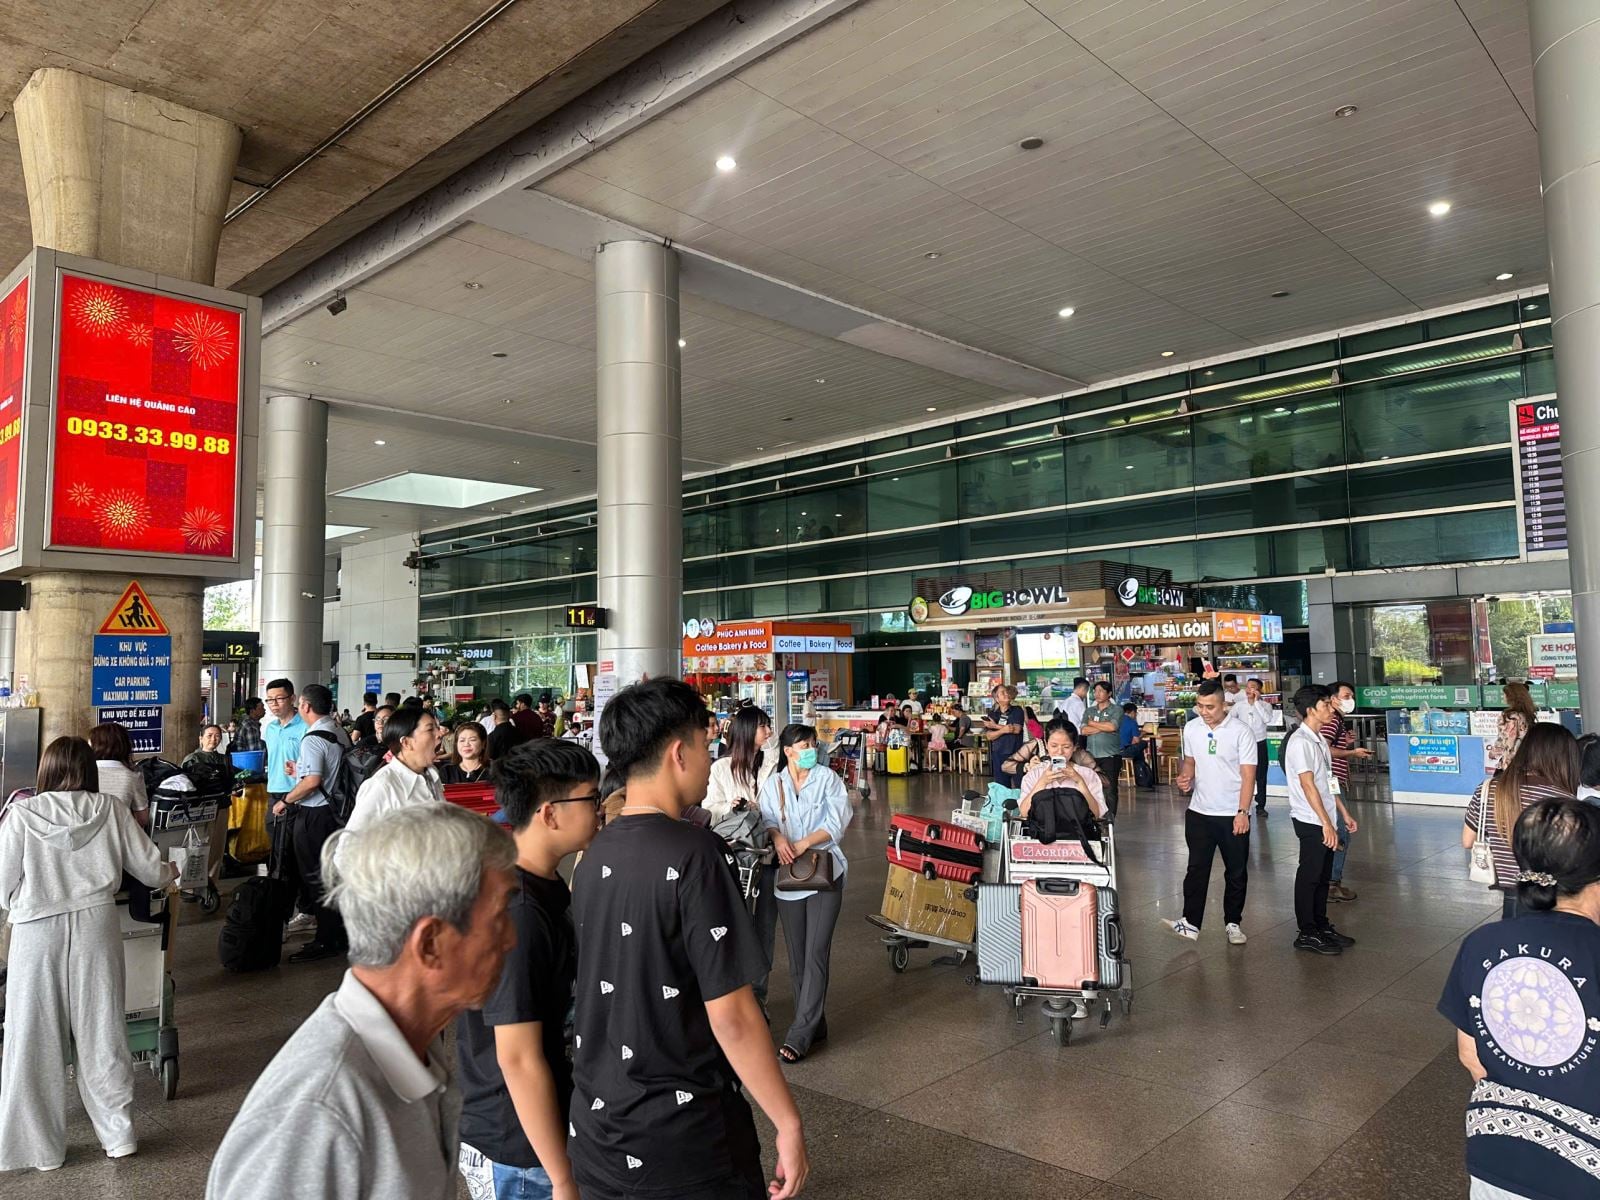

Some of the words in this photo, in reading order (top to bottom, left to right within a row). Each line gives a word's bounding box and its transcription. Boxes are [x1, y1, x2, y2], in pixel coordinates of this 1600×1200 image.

[106, 394, 127, 404] LIÊN
[130, 398, 142, 408] HỆ
[144, 400, 175, 412] QUẢNG
[178, 405, 196, 414] CÁO
[67, 417, 230, 454] 0933.33.99.88
[568, 609, 584, 624] 11
[717, 629, 733, 638] PHÚC
[1100, 623, 1124, 640] MÓN
[1126, 624, 1159, 639] NGON
[1162, 620, 1180, 638] SÀI
[1183, 619, 1210, 637] GÒN
[119, 642, 132, 651] KHU
[135, 640, 147, 654] VỰC
[228, 645, 243, 655] 12
[695, 643, 717, 652] Coffee
[719, 642, 741, 651] Bakery
[750, 640, 767, 648] Food
[810, 640, 831, 649] Bakery
[838, 640, 852, 648] Food
[1541, 644, 1553, 652] XE
[110, 656, 118, 666] XE
[119, 655, 138, 666] KHÔNG
[138, 654, 150, 666] QUÁ
[150, 657, 154, 666] 3
[155, 654, 169, 666] PHÚT
[114, 676, 126, 686] CAR
[127, 676, 150, 686] PARKING
[103, 691, 129, 701] MAXIMUM
[130, 691, 134, 700] 3
[135, 690, 158, 700] MINUTES
[1363, 688, 1387, 697] Grab
[116, 710, 128, 720] VỰC
[138, 709, 146, 717] XE
[1035, 848, 1086, 857] AGRIBAN
[1482, 944, 1587, 988] SAKURA
[1474, 1014, 1488, 1037] THE
[1486, 1040, 1531, 1074] BEAUTY
[1560, 1037, 1597, 1074] NATURE
[460, 1149, 486, 1168] DAILY
